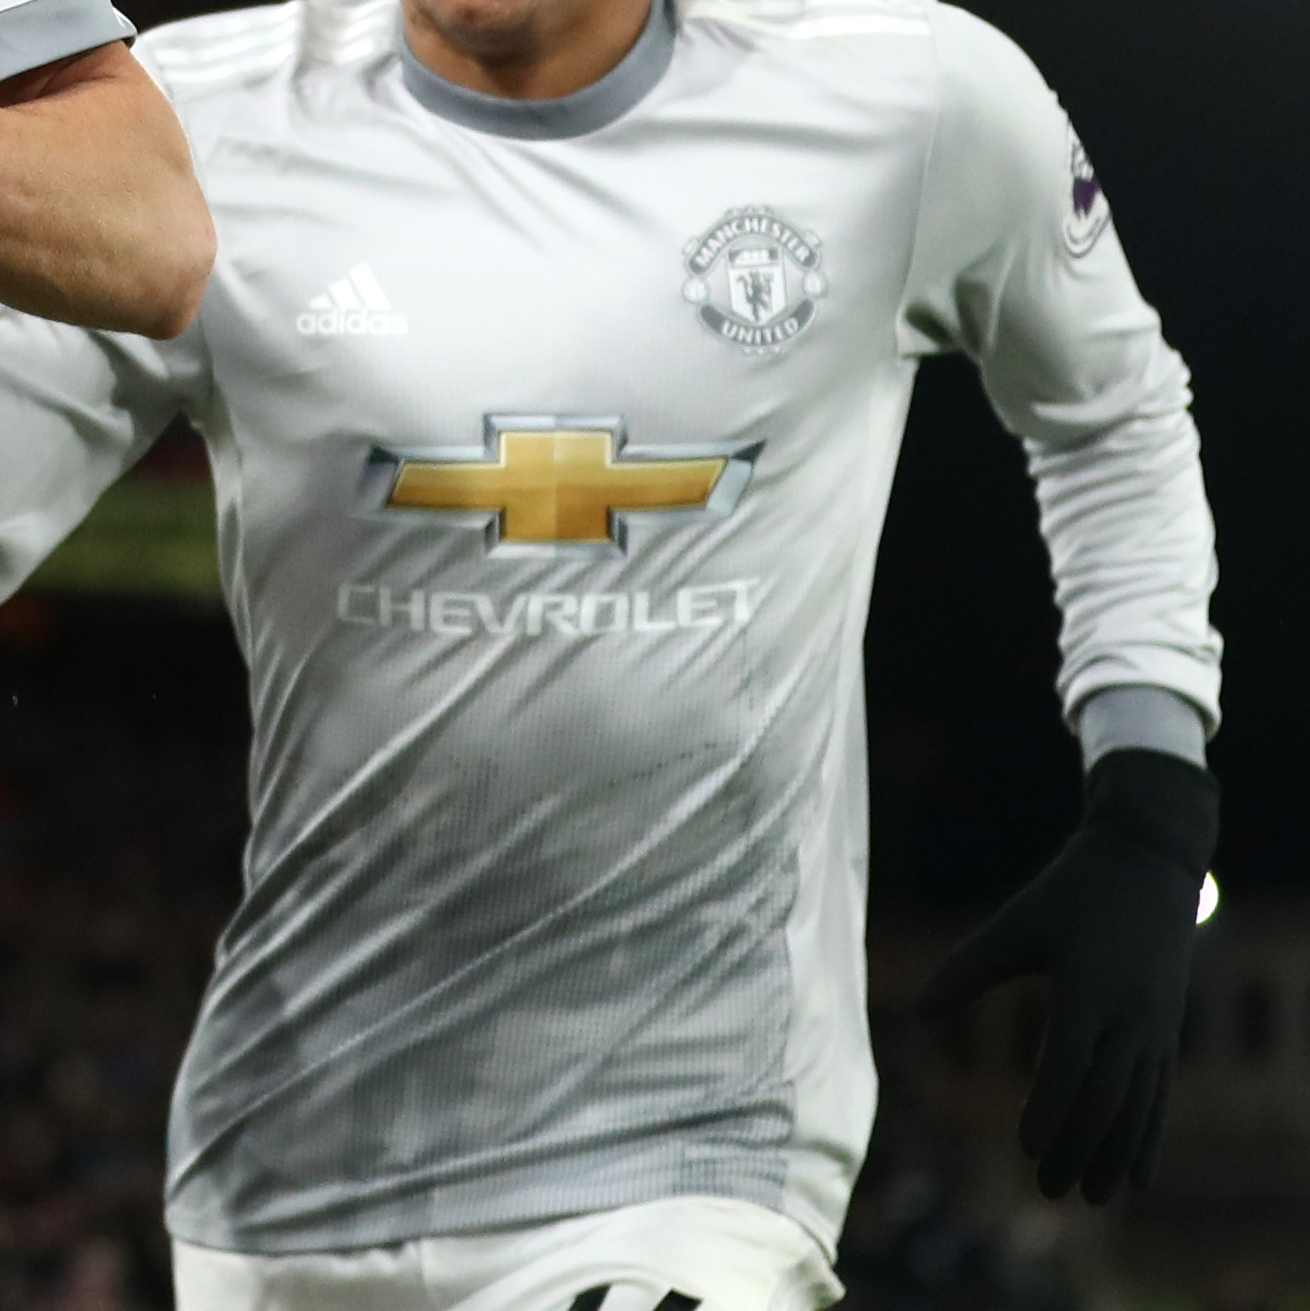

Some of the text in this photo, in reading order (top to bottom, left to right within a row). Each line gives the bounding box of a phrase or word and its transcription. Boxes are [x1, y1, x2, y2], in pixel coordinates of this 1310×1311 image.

[694, 216, 810, 266] MANCHESTER
[296, 305, 409, 336] adidas
[722, 316, 799, 344] UNITED
[336, 577, 760, 637] CHEVROLET
